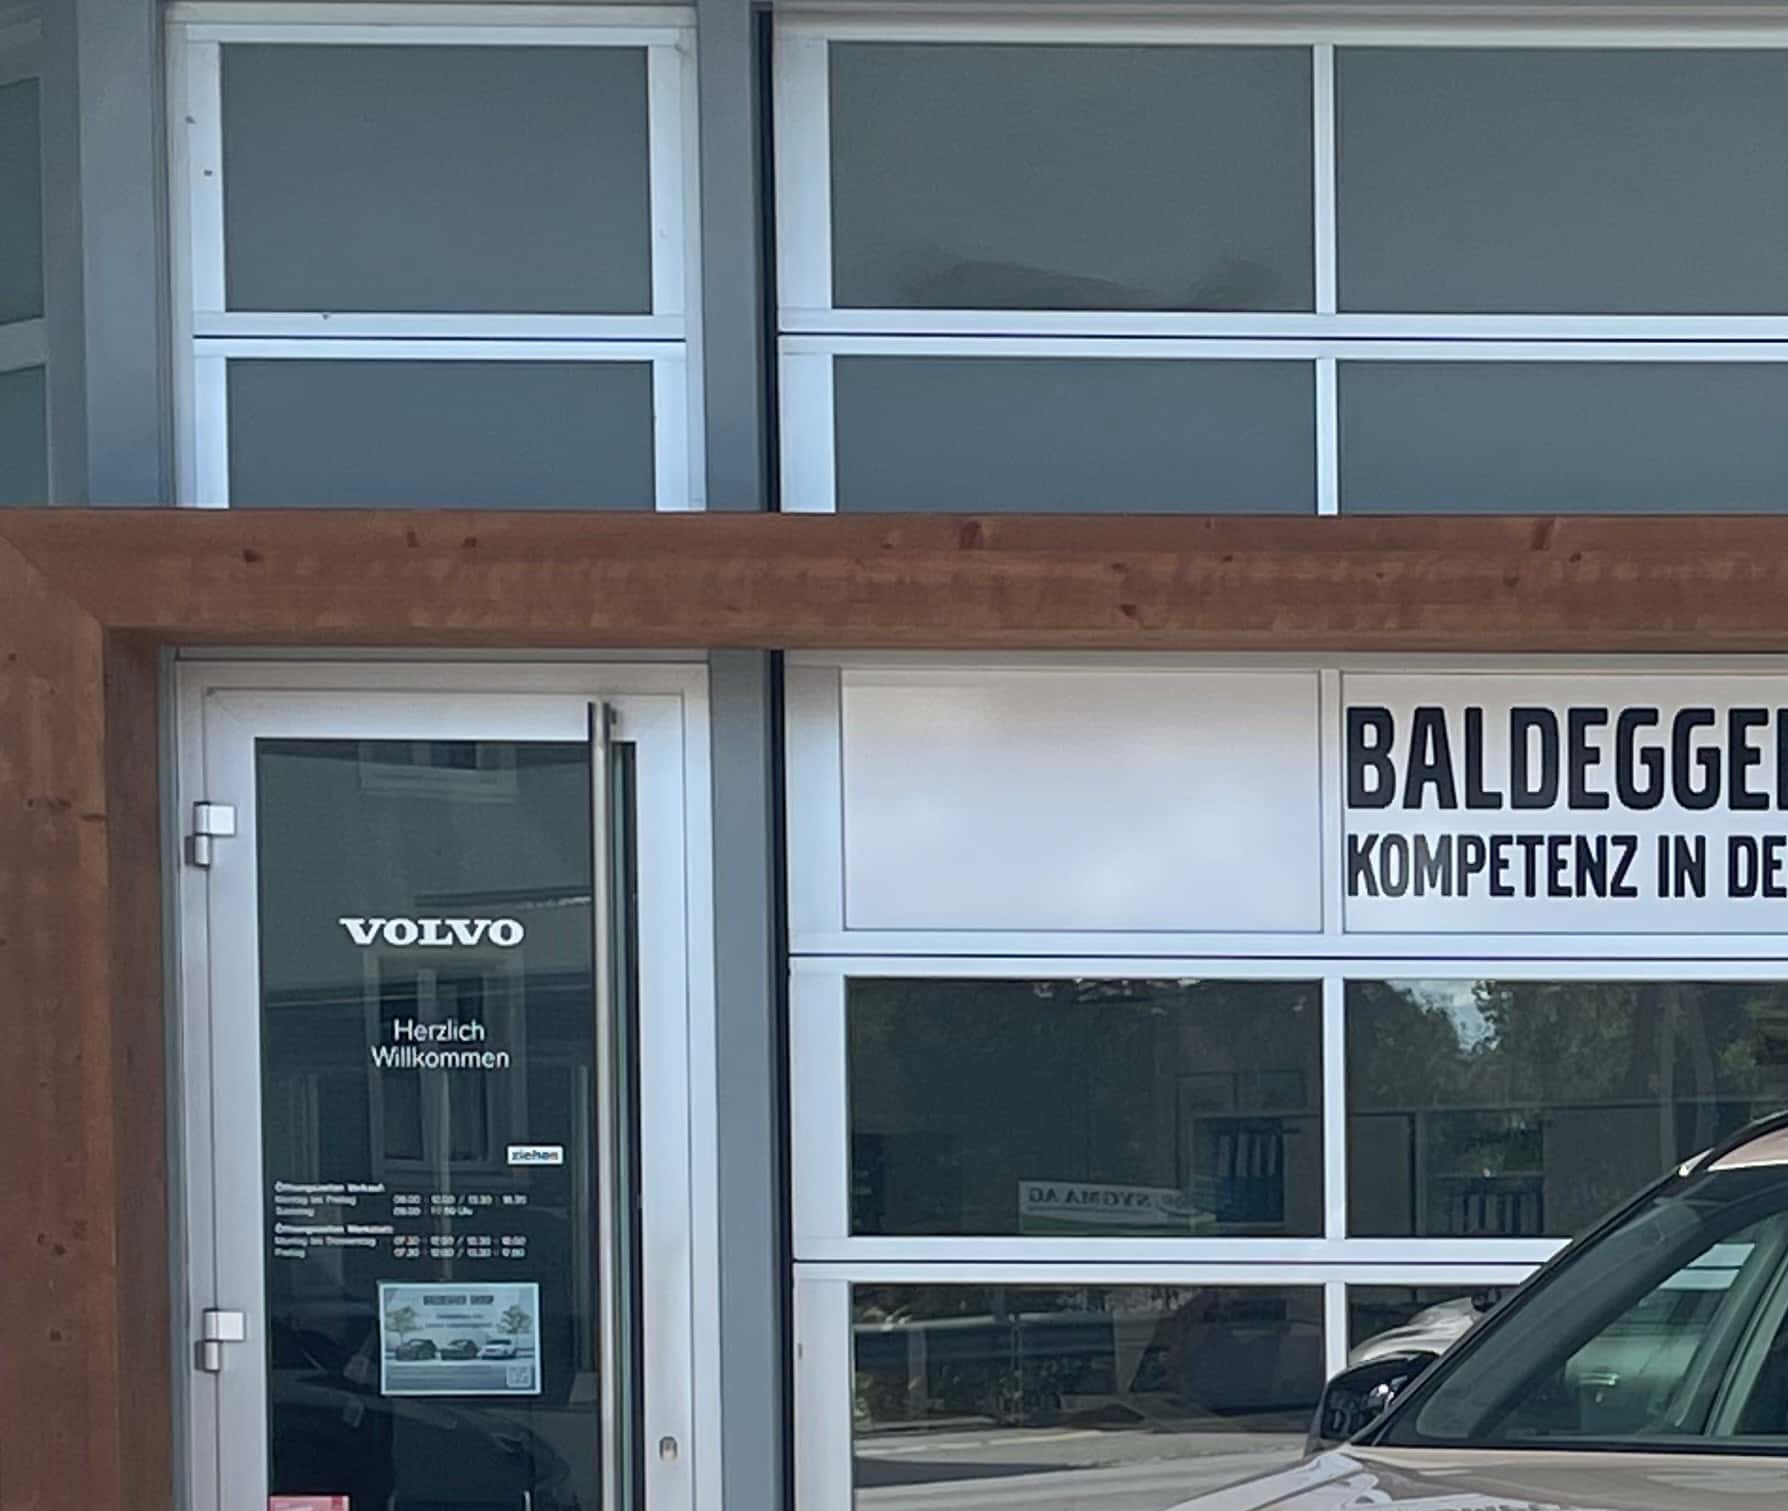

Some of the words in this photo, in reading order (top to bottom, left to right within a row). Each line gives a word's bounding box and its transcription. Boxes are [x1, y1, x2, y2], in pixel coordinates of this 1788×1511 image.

[1346, 834, 1639, 899] KOMPETENZ
[1657, 835, 1707, 898] IN
[338, 917, 525, 946] VOLVO
[393, 1018, 486, 1041] Herzlich
[370, 1045, 510, 1069] Willkommen
